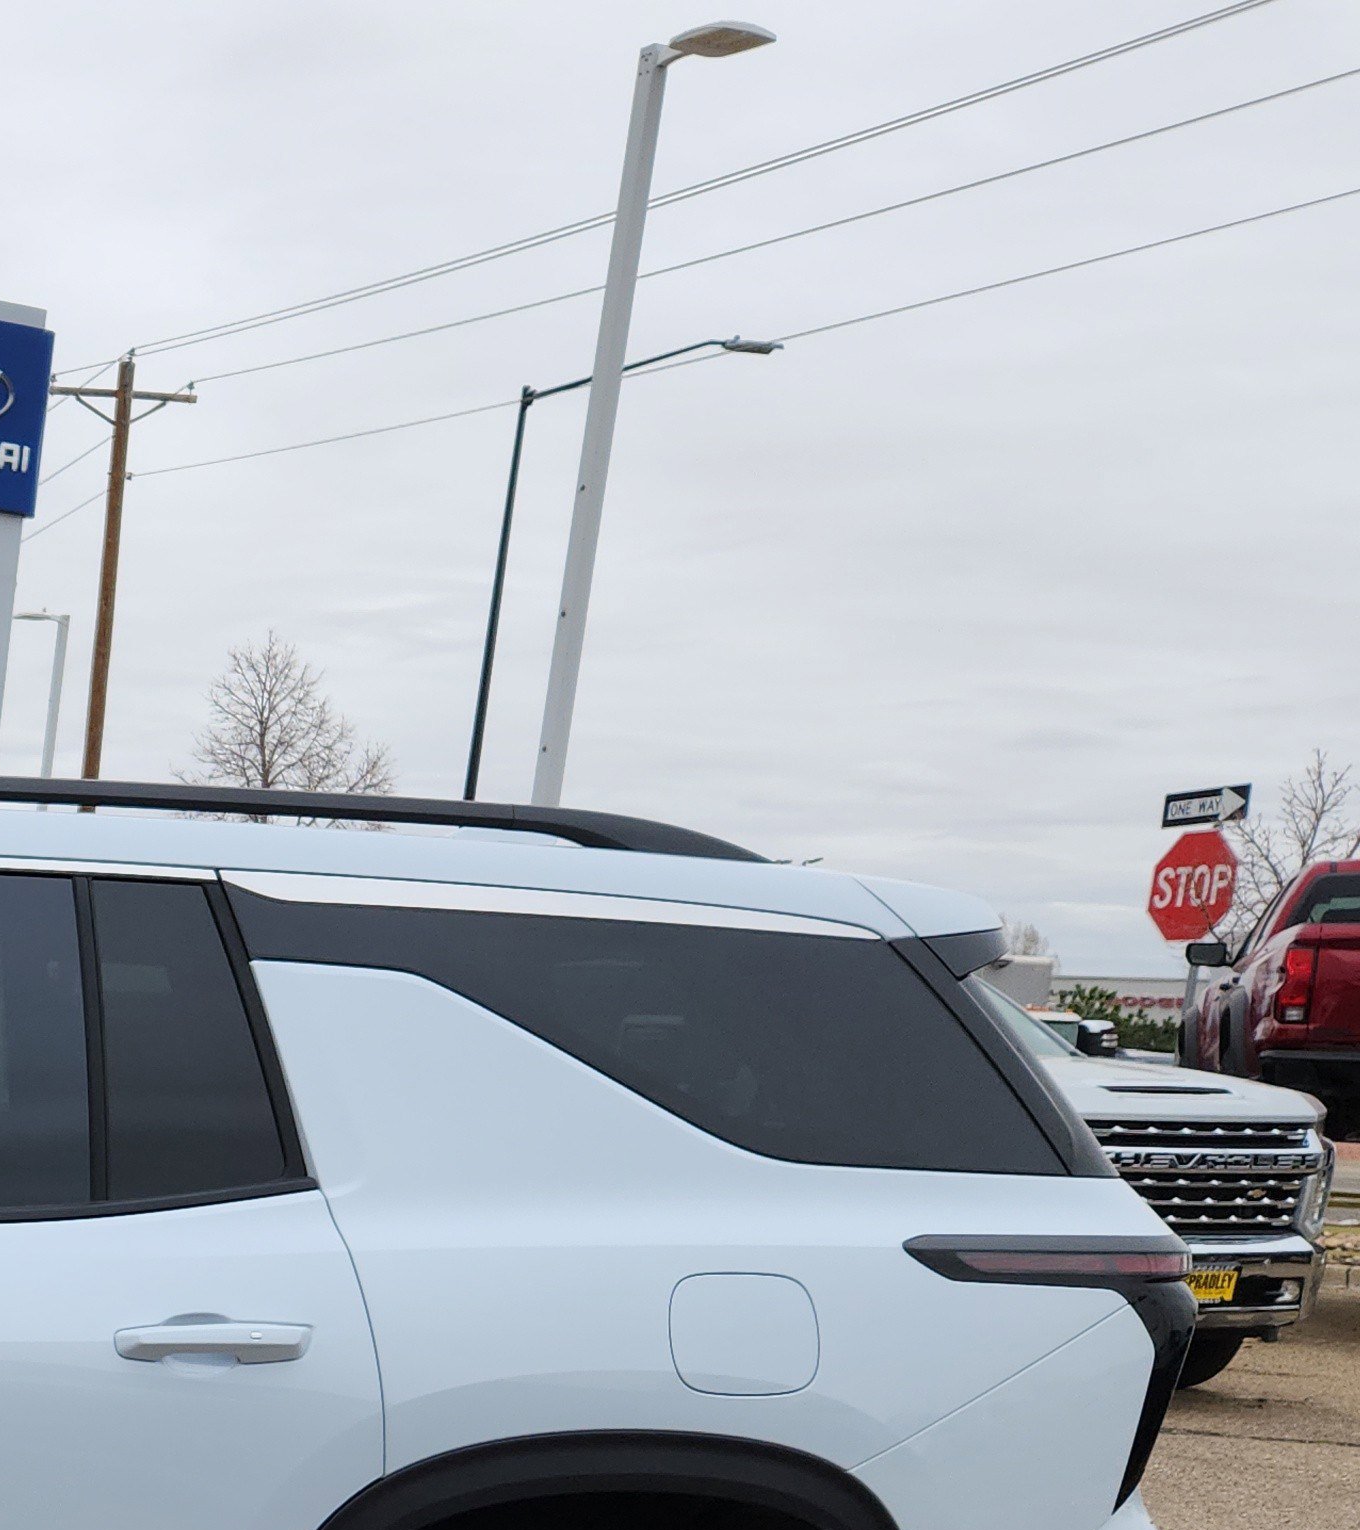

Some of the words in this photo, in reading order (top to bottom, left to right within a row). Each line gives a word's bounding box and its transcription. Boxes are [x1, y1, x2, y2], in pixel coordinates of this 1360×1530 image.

[1170, 801, 1191, 817] ONE
[1198, 798, 1221, 814] WAY
[1152, 864, 1233, 909] STOP
[1187, 1272, 1235, 1290] PRADLEY
